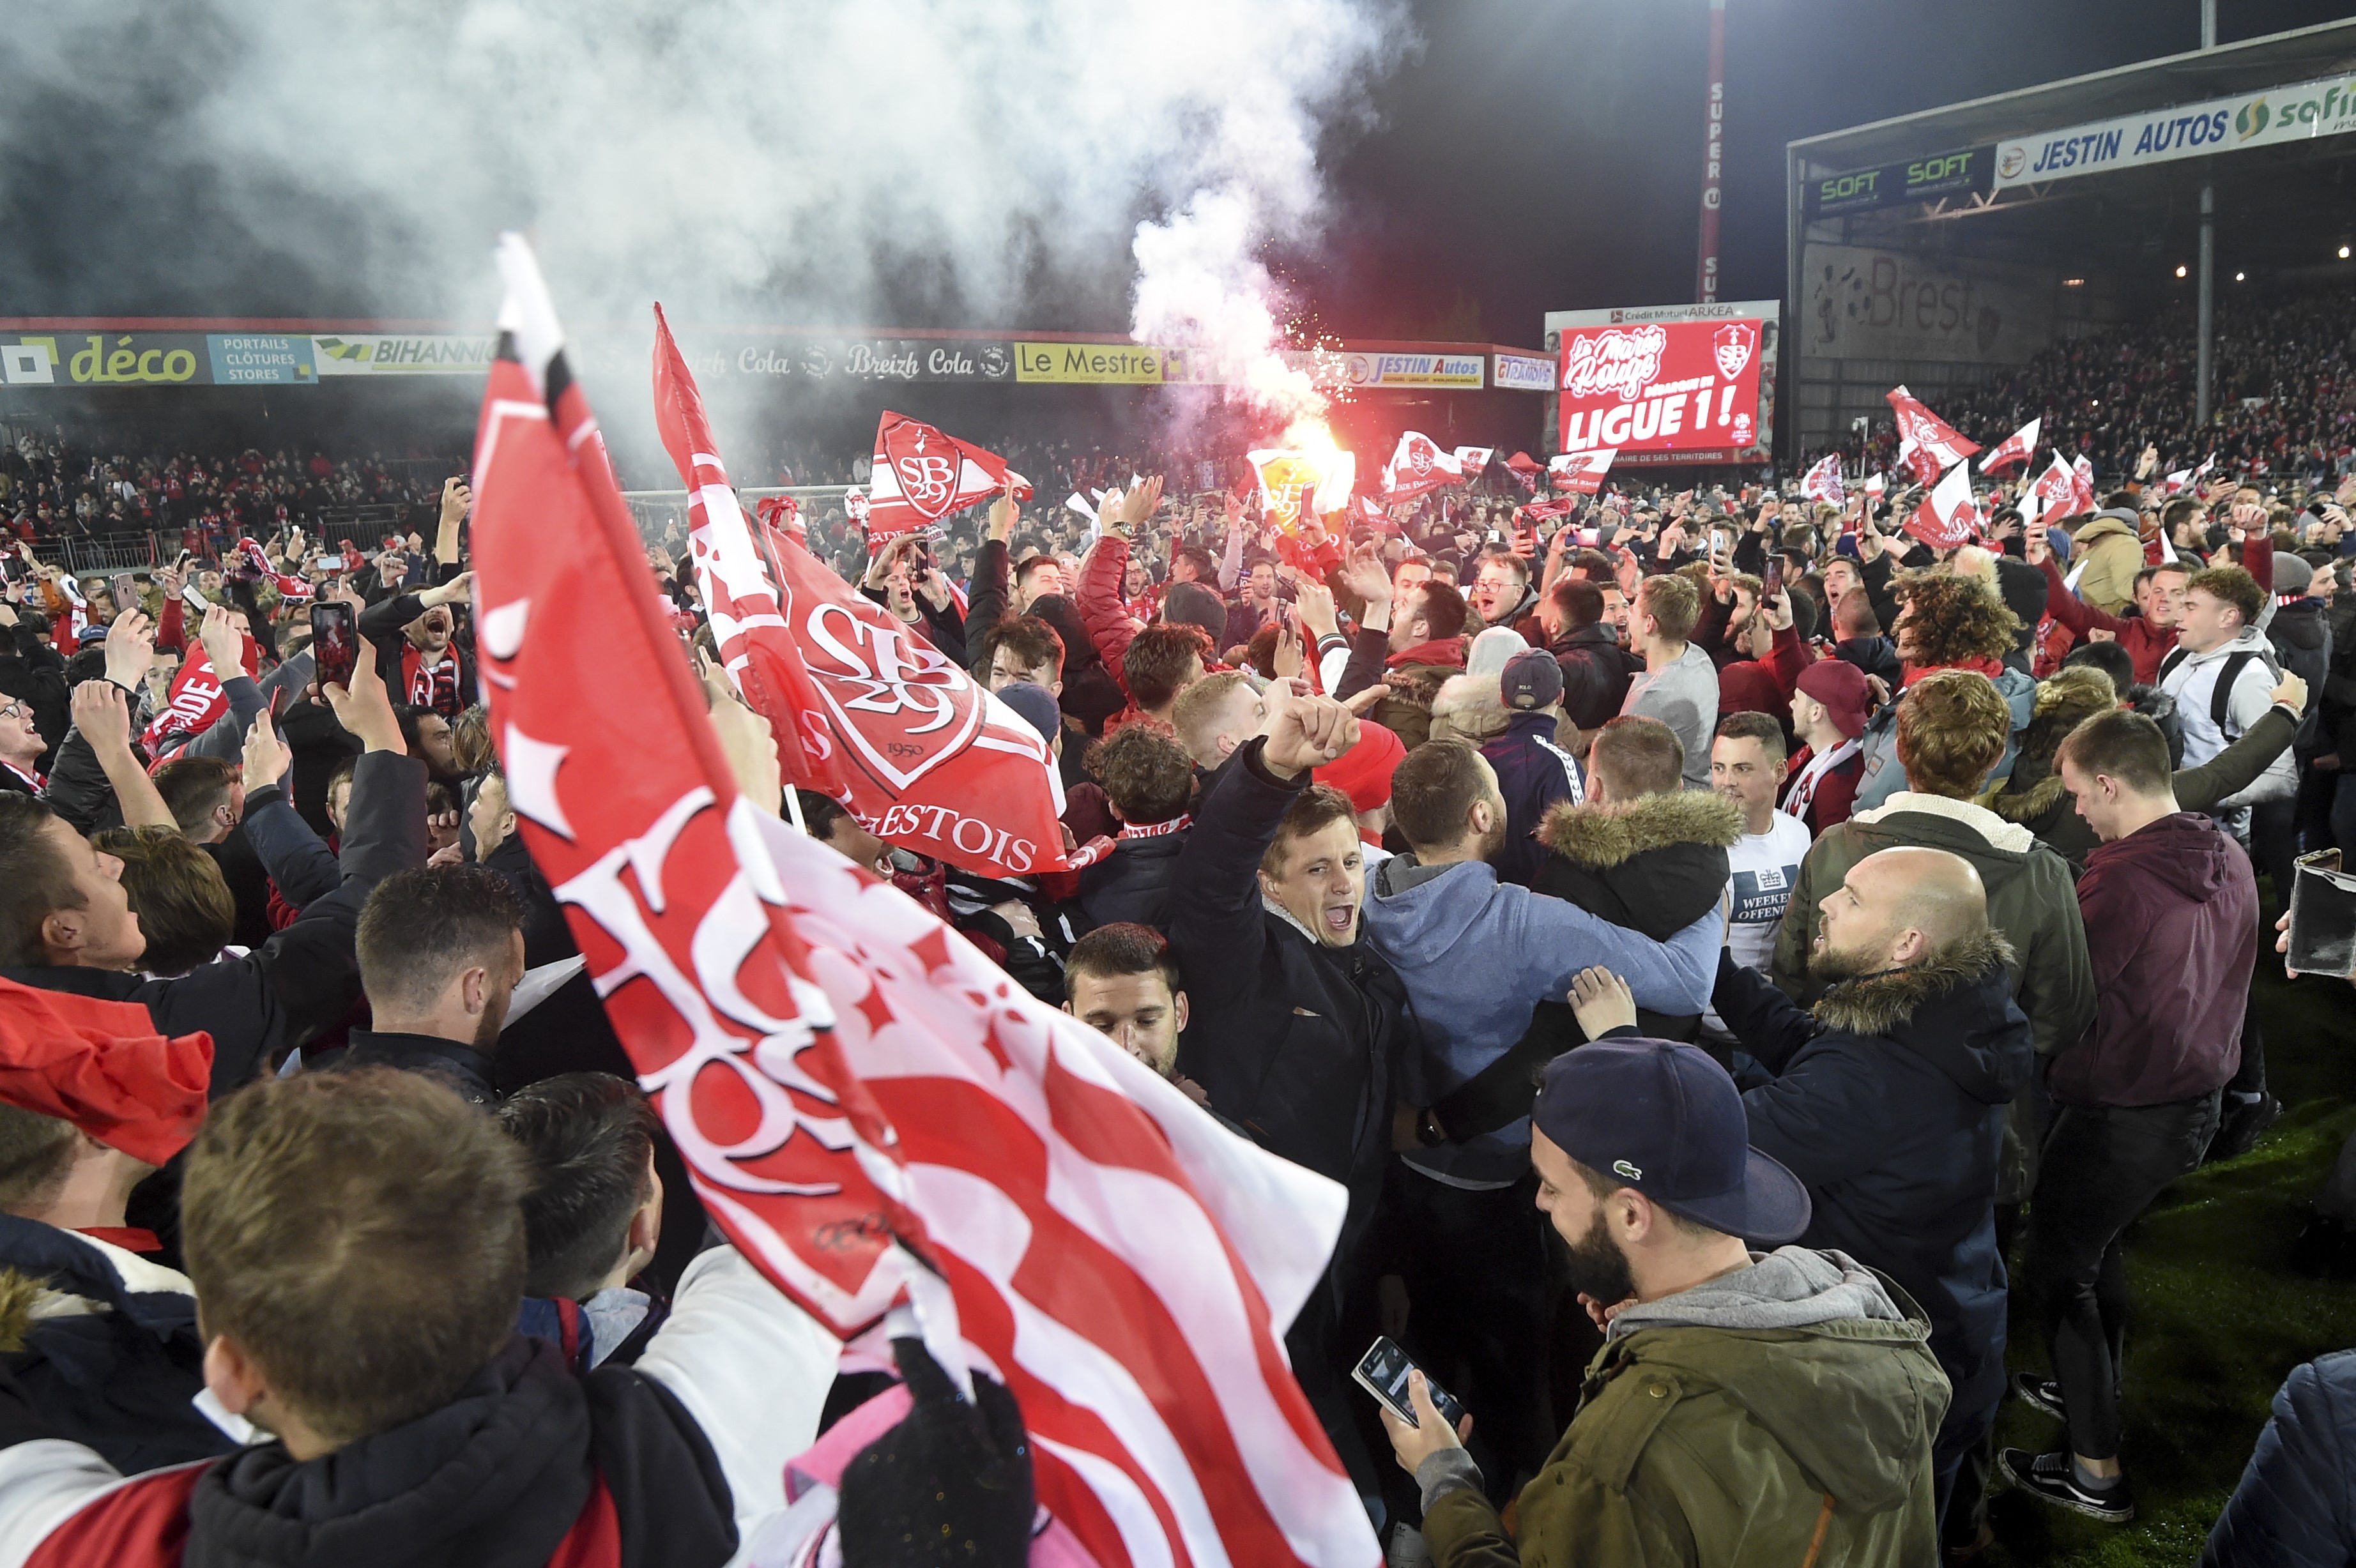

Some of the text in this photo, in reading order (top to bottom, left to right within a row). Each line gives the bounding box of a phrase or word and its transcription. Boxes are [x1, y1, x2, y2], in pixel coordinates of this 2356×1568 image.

[1710, 82, 1723, 178] SUPER
[2033, 110, 2229, 172] JESTIN AUTOS
[1908, 153, 1973, 184] SOFT
[1821, 171, 1880, 201] SOFT
[1870, 256, 1974, 331] Brest
[1625, 306, 1734, 320] Crédit Mutuel ARKEA
[70, 335, 196, 382] déco
[224, 339, 289, 349] PORTAILS
[226, 351, 296, 365] CLÔTURES
[1597, 330, 1662, 363] Marée
[738, 347, 790, 374] Cola
[845, 344, 920, 379] Breizh
[928, 348, 974, 374] Cola
[1022, 345, 1052, 372] Le
[1064, 347, 1156, 374] Mestre
[1370, 356, 1430, 382] JESTIN
[1434, 358, 1478, 374] Autos
[229, 369, 279, 380] STORES
[1567, 354, 1656, 395] Rouge
[1566, 385, 1736, 452] LIGUE 1 !
[899, 456, 954, 485] SB
[1640, 453, 1651, 462] DE
[1653, 453, 1670, 461] SES
[1671, 452, 1723, 461] TERRITOIRES
[912, 482, 947, 505] 29
[1396, 482, 1412, 491] TADE
[797, 602, 969, 692] SB
[838, 677, 955, 734] 29
[887, 742, 924, 758] 1950
[1743, 893, 1791, 909] WEEKE
